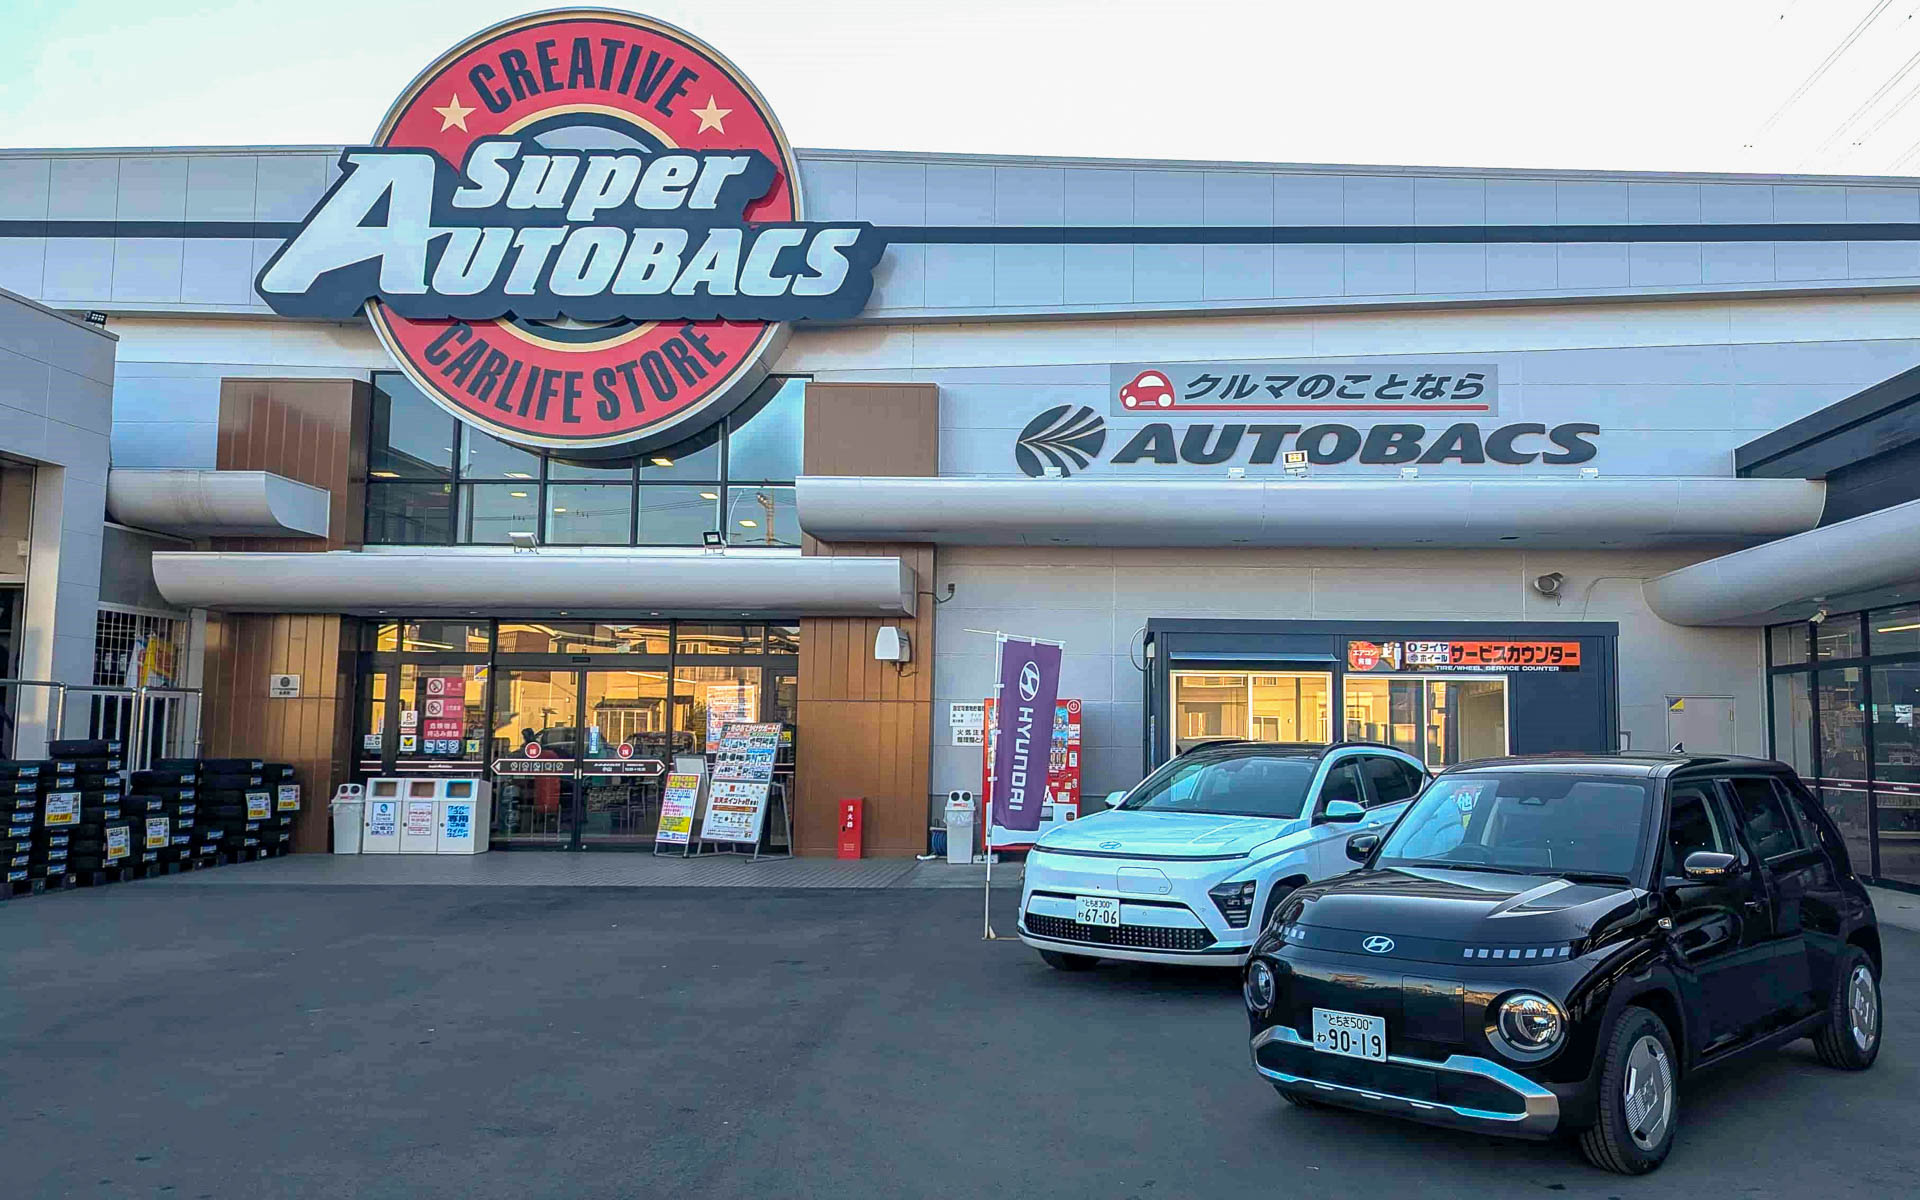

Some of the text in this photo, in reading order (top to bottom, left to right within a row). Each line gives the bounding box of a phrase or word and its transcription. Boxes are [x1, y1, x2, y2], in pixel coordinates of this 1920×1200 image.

[468, 37, 701, 117] CREATIVE
[452, 141, 750, 221] Super
[260, 153, 861, 296] AUTOBACS
[424, 324, 728, 424] CARLIFE STORE
[1184, 373, 1485, 400] クルマのことなら
[1110, 423, 1600, 465] AUTOBACS
[1420, 643, 1448, 652] タイヤ
[1451, 645, 1578, 663] サービスカウンター
[1008, 706, 1034, 811] HYUNDAI
[1085, 908, 1117, 925] 67-06
[1317, 1028, 1381, 1057] わ 90-19
